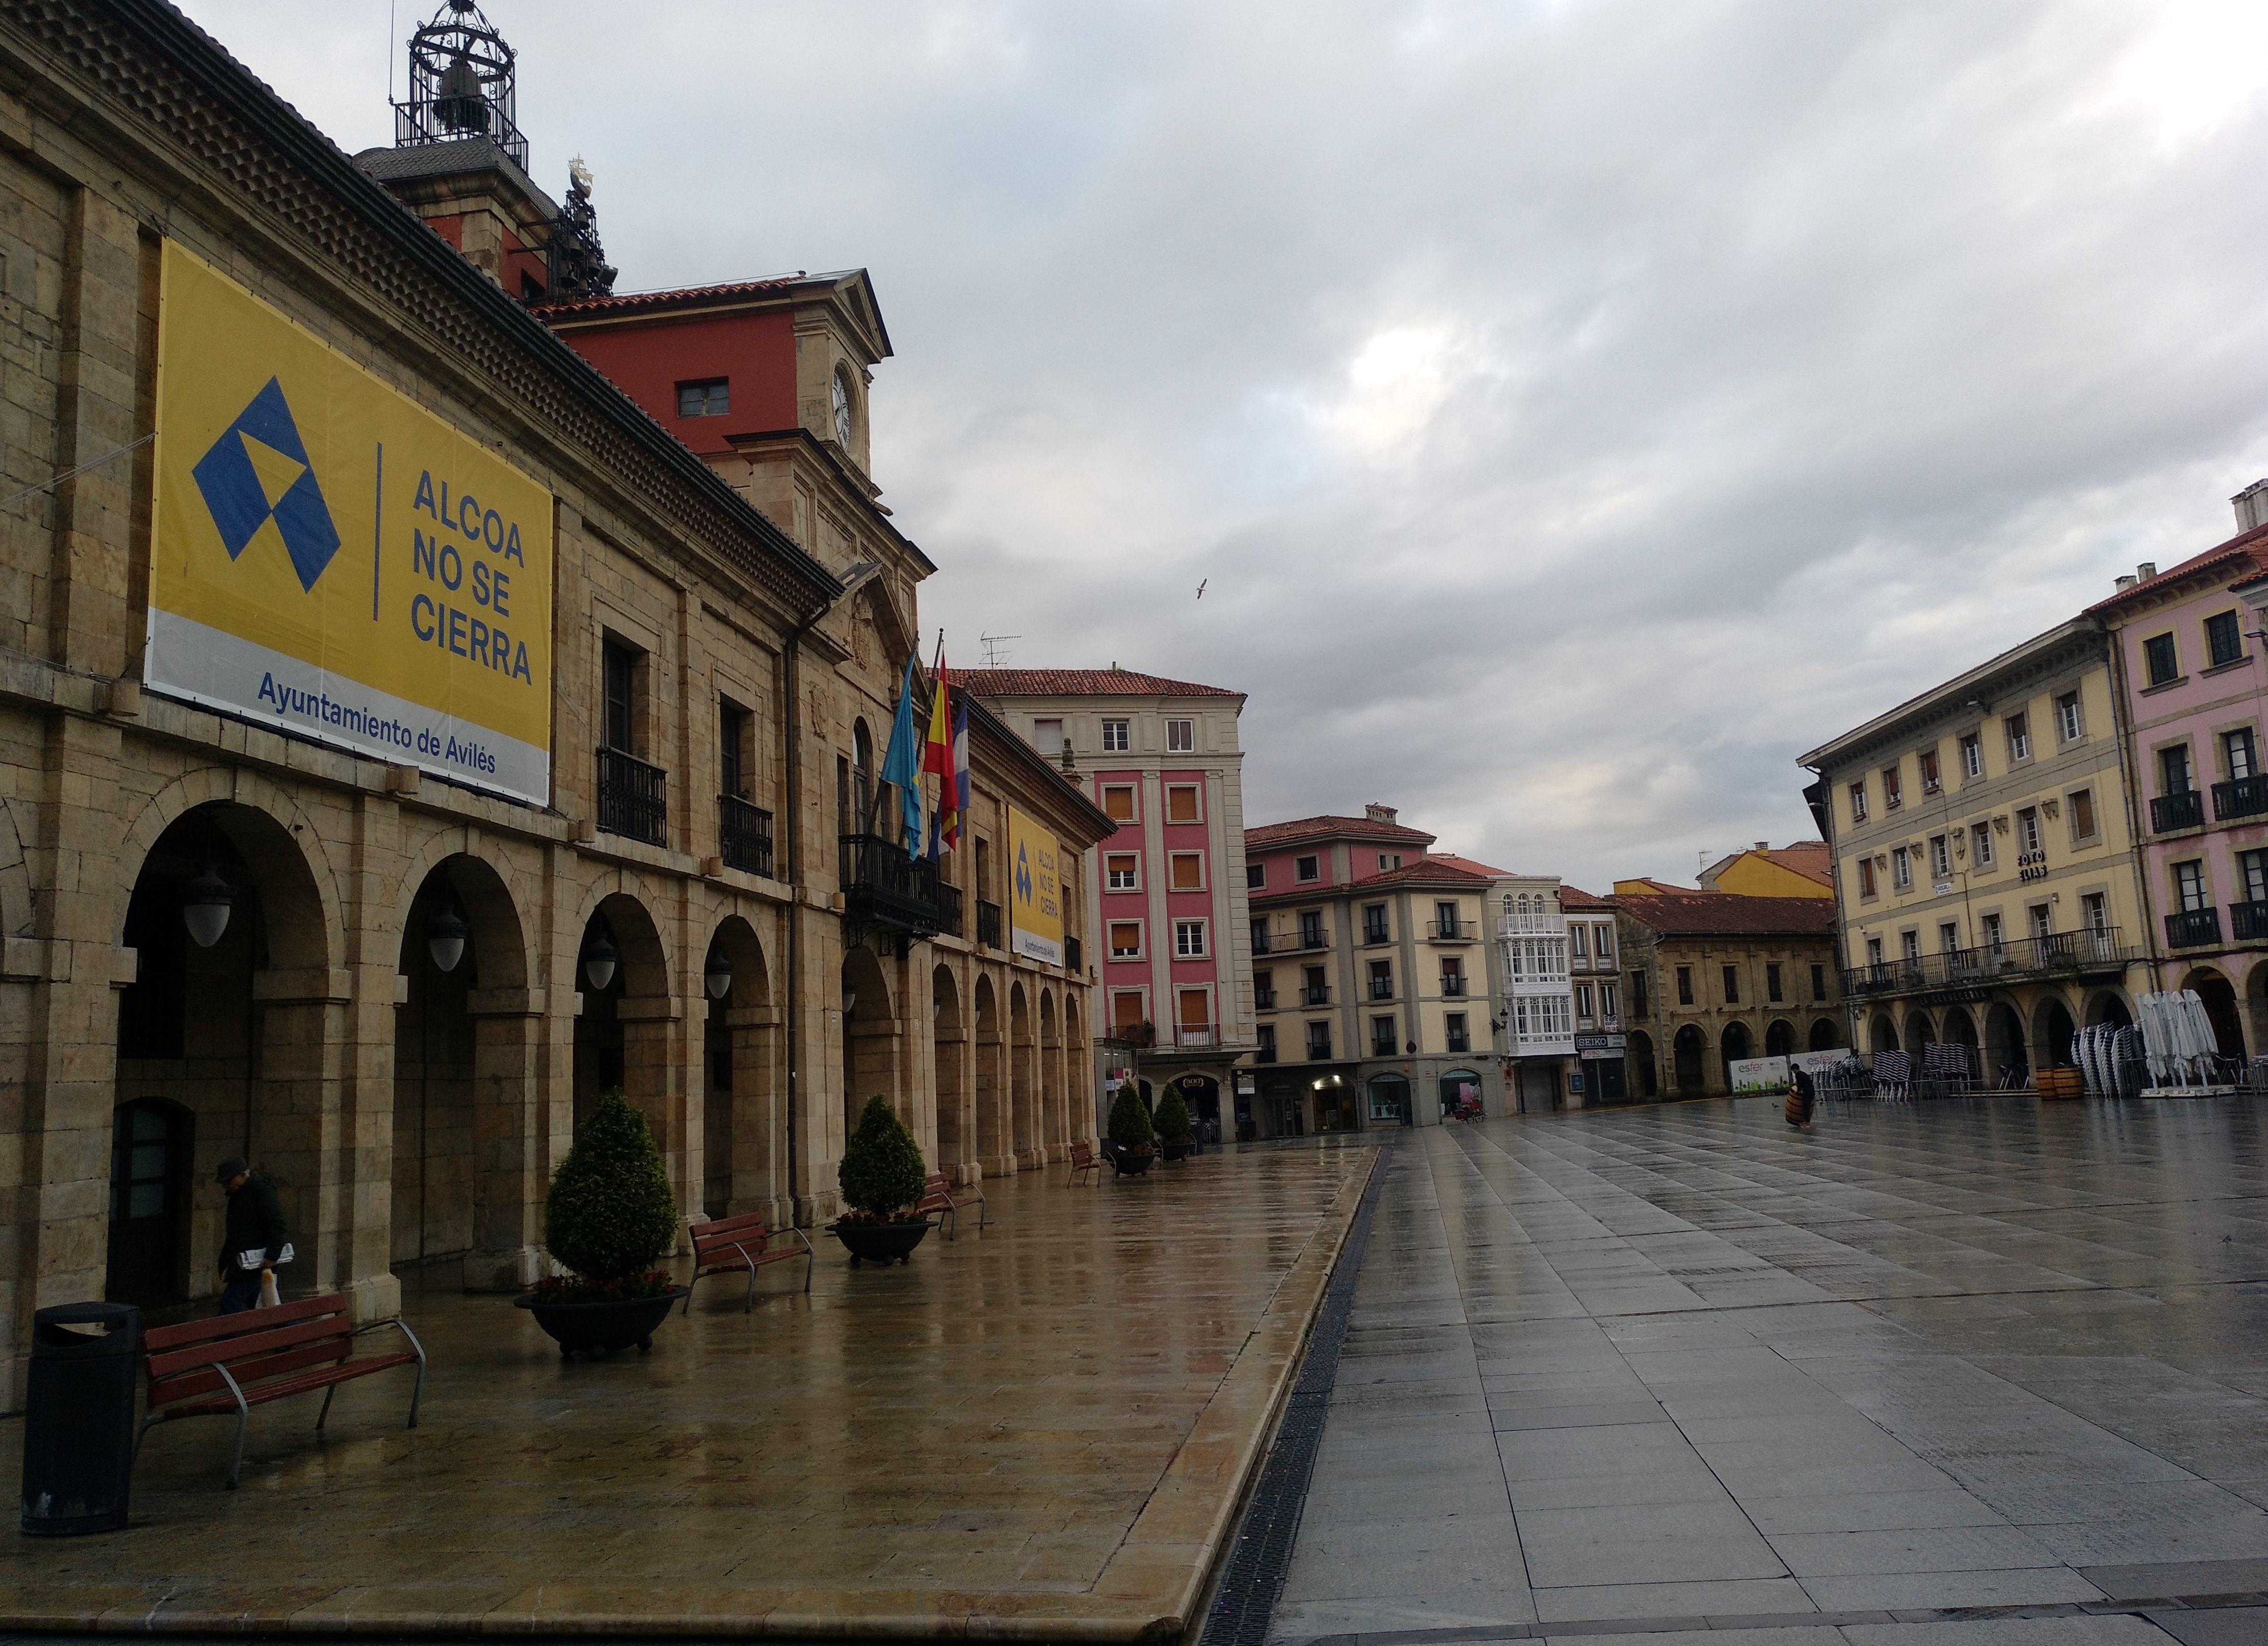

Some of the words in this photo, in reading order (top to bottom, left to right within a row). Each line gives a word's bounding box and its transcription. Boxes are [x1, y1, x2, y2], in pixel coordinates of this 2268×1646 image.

[413, 470, 524, 569] ALCOA
[414, 527, 462, 591] NO
[472, 561, 510, 617] SE
[411, 594, 532, 686] CIERRA
[258, 671, 412, 748] Ayuntamiento
[418, 728, 441, 757] de
[445, 736, 496, 773] Avilés
[1039, 849, 1055, 874] ALCOA
[2017, 851, 2044, 866] FOTO
[1040, 872, 1047, 891] NO
[1048, 878, 1054, 895] SE
[2019, 865, 2046, 881] ELIAS
[1041, 896, 1058, 919] CIERRA
[1578, 1037, 1607, 1047] SEIKO
[1739, 1062, 1764, 1073] esfer
[1807, 1054, 1834, 1065] esfer
